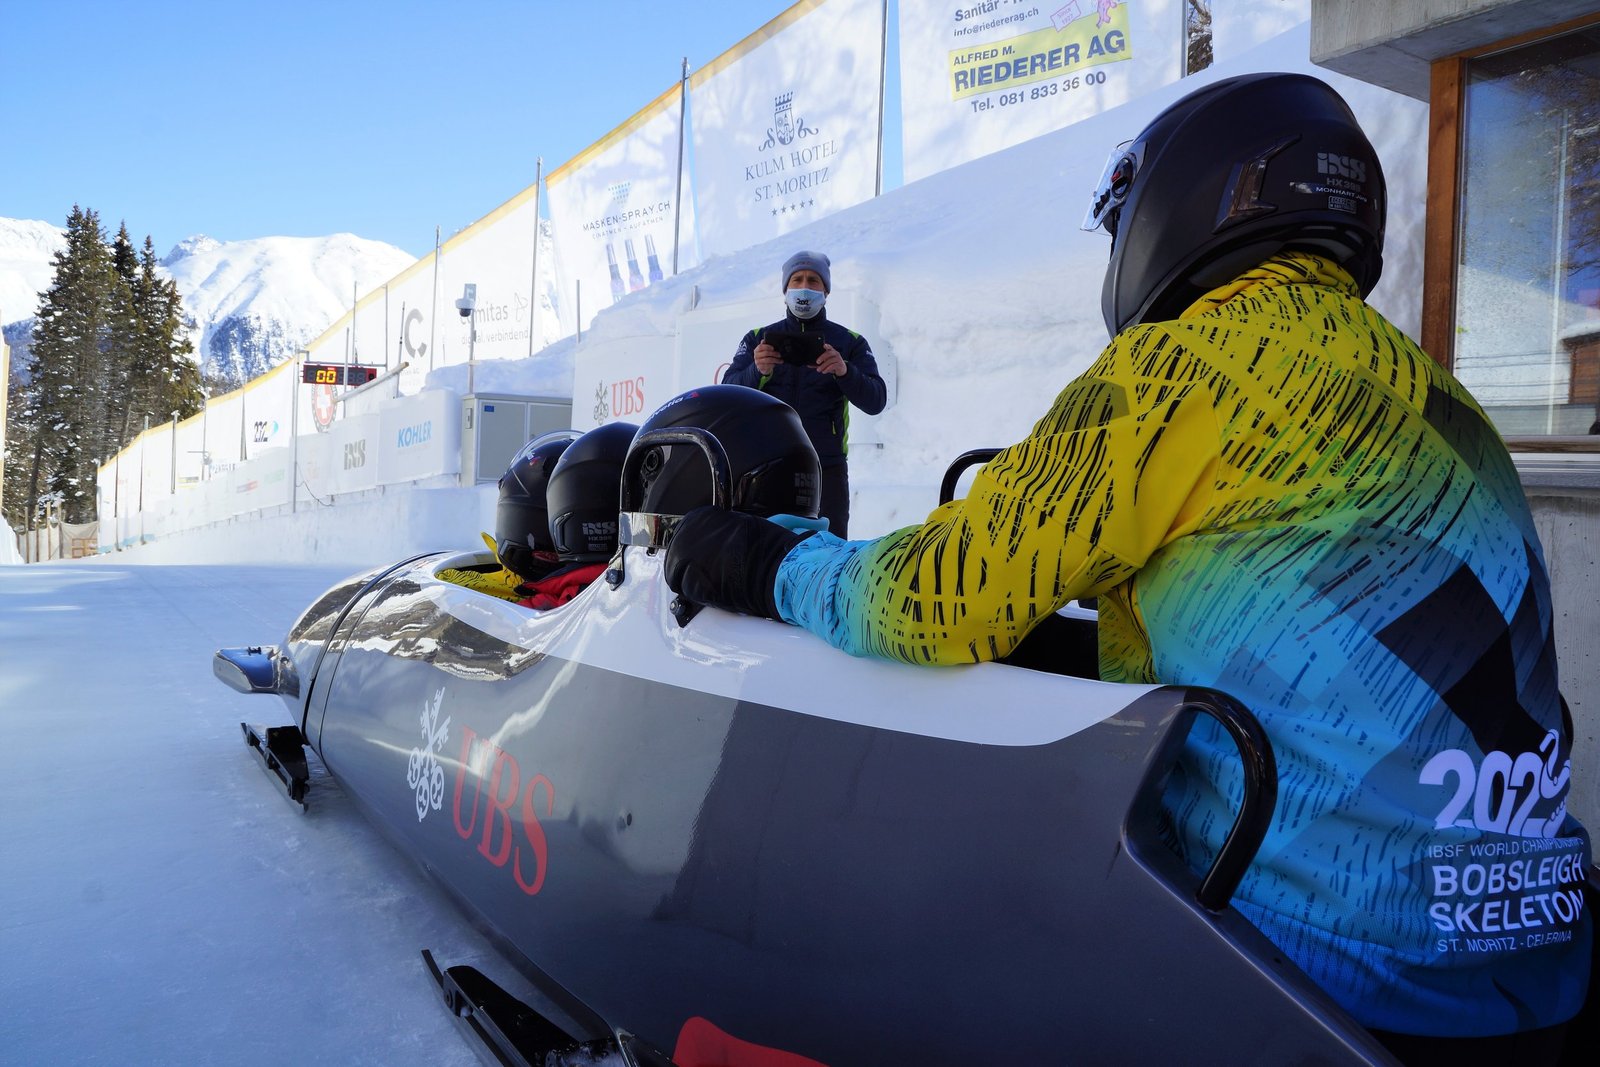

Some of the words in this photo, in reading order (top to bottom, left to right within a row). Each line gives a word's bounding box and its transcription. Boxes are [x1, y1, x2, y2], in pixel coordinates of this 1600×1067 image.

[953, 7, 1039, 37] info@riedererag.ch
[954, 0, 1000, 22] Sanitär
[953, 48, 998, 66] ALFRED
[1001, 45, 1016, 56] M.
[954, 43, 1081, 92] RIEDERER
[1086, 30, 1125, 60] AG
[970, 97, 995, 114] Tel.
[999, 91, 1025, 107] 081
[1030, 83, 1058, 100] 833
[1062, 77, 1080, 92] 36
[1085, 71, 1107, 86] 00
[745, 156, 785, 182] KULM
[790, 139, 838, 168] HOTEL
[754, 184, 774, 202] ST.
[776, 167, 829, 197] MORITZ
[316, 370, 337, 384] 00
[611, 376, 645, 418] UBS
[397, 420, 432, 448] KOHLER
[453, 724, 555, 896] UBS
[1428, 844, 1465, 859] IBSF
[1470, 841, 1520, 858] WORLD
[1432, 852, 1586, 897] BOBSLEIGH
[1429, 888, 1585, 933] SKELETON
[1437, 938, 1463, 952] ST.
[1467, 936, 1518, 953] MORITZ
[1526, 929, 1573, 949] CELERINA
